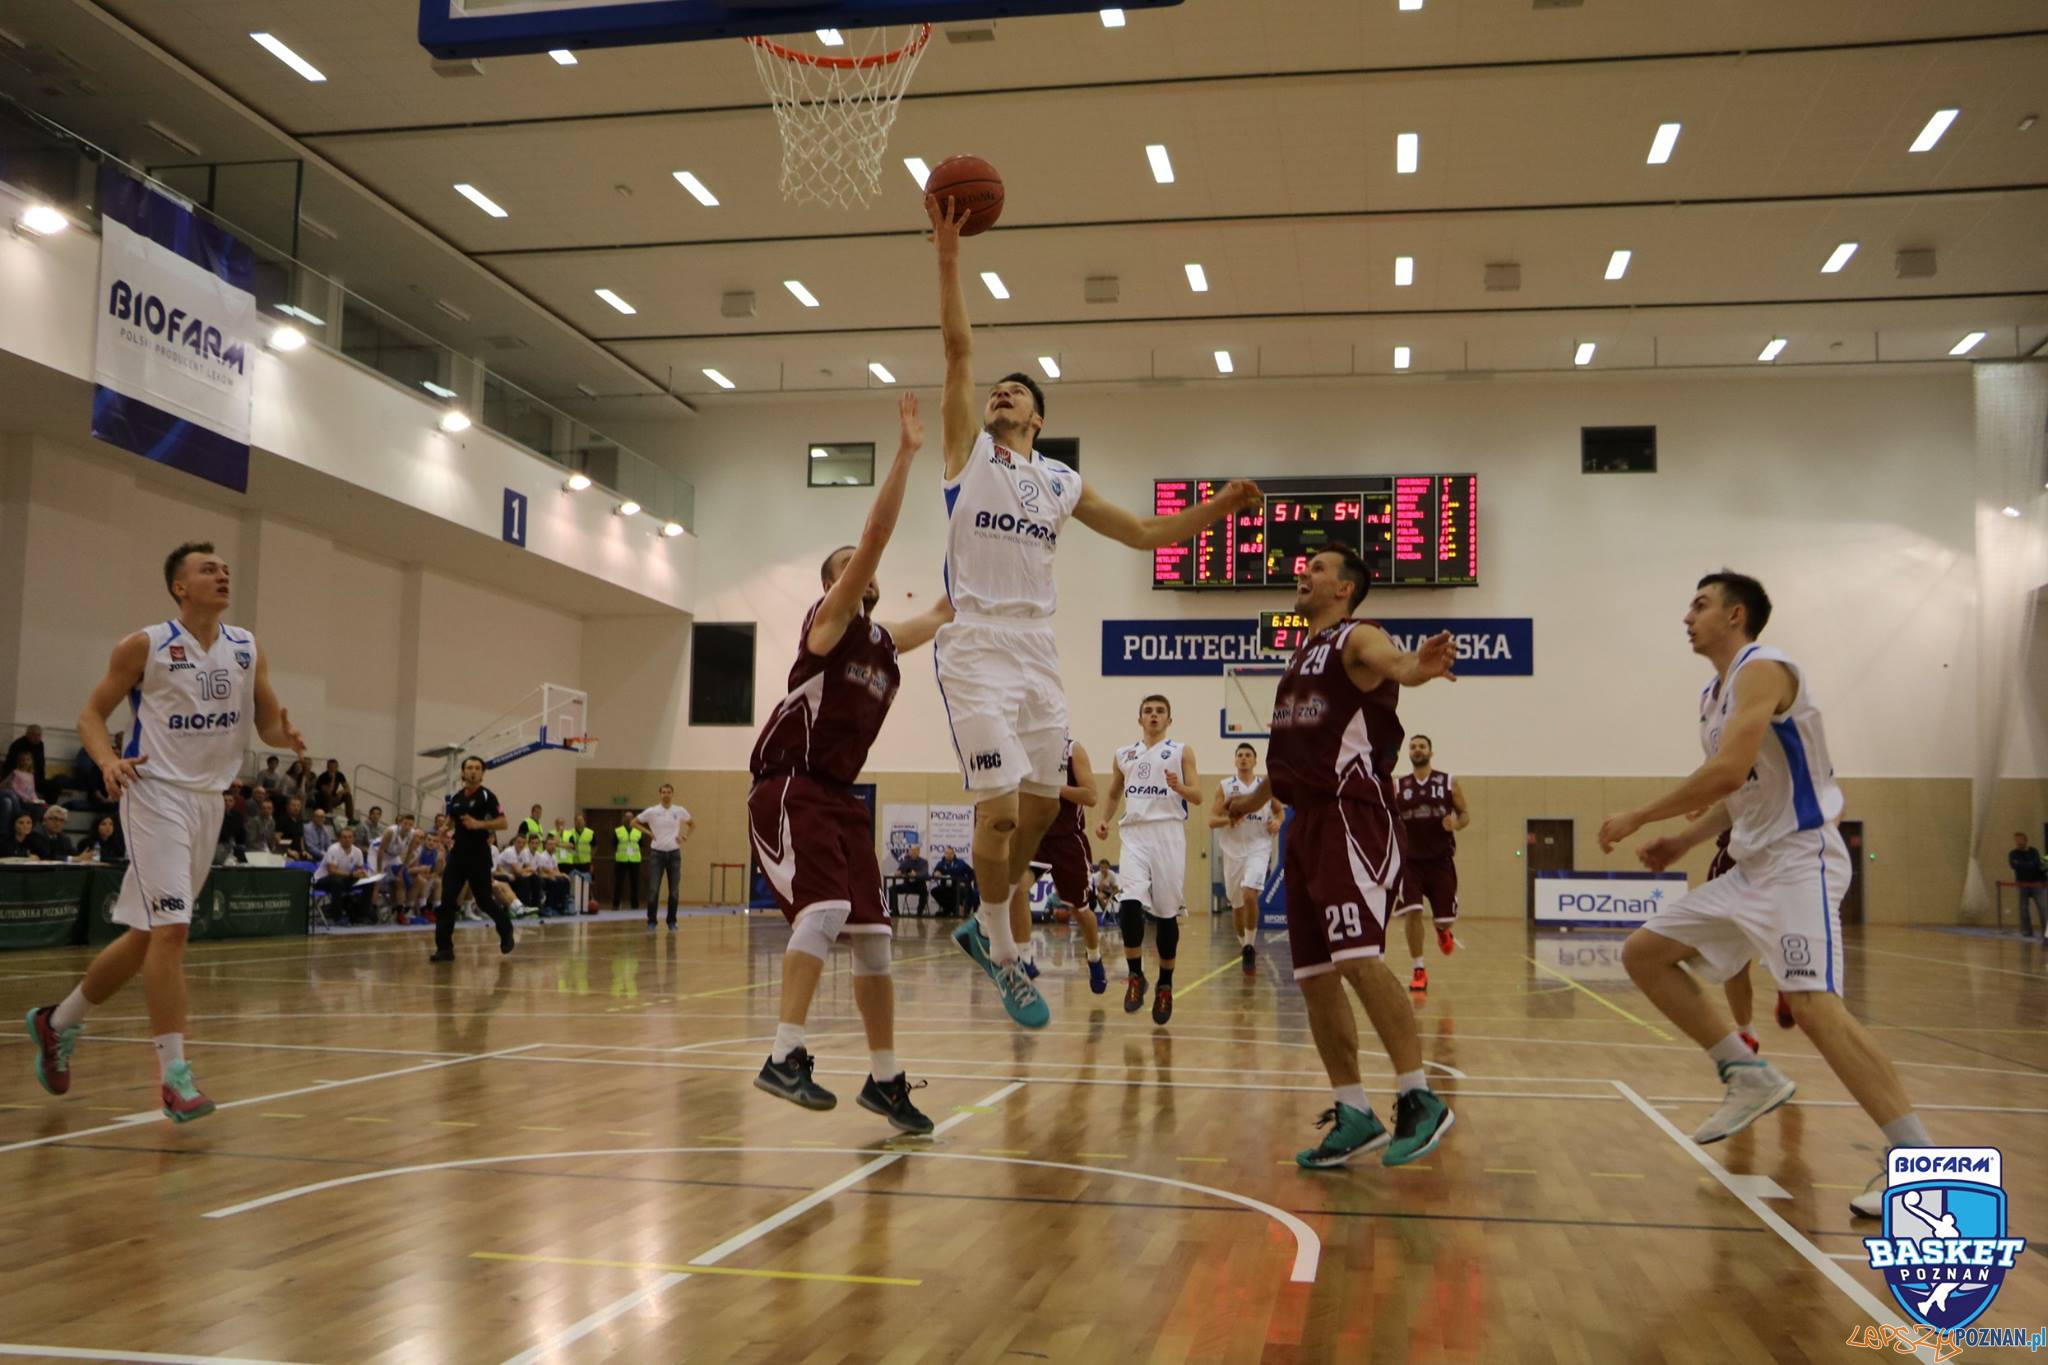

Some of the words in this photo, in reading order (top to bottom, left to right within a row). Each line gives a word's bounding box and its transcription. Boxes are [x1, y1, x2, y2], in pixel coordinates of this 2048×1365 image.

[109, 279, 245, 376] BIOFARM
[1018, 480, 1039, 513] 2
[1275, 504, 1300, 521] 51
[1334, 502, 1360, 521] 54
[511, 498, 520, 540] 1
[1300, 643, 1331, 675] 29
[195, 669, 232, 701] 16
[168, 711, 240, 730] BIOFAR
[976, 752, 1002, 770] PBG
[1137, 761, 1152, 780] 3
[1431, 785, 1444, 798] 14
[1325, 902, 1363, 942] 29
[1780, 933, 1811, 967] 8
